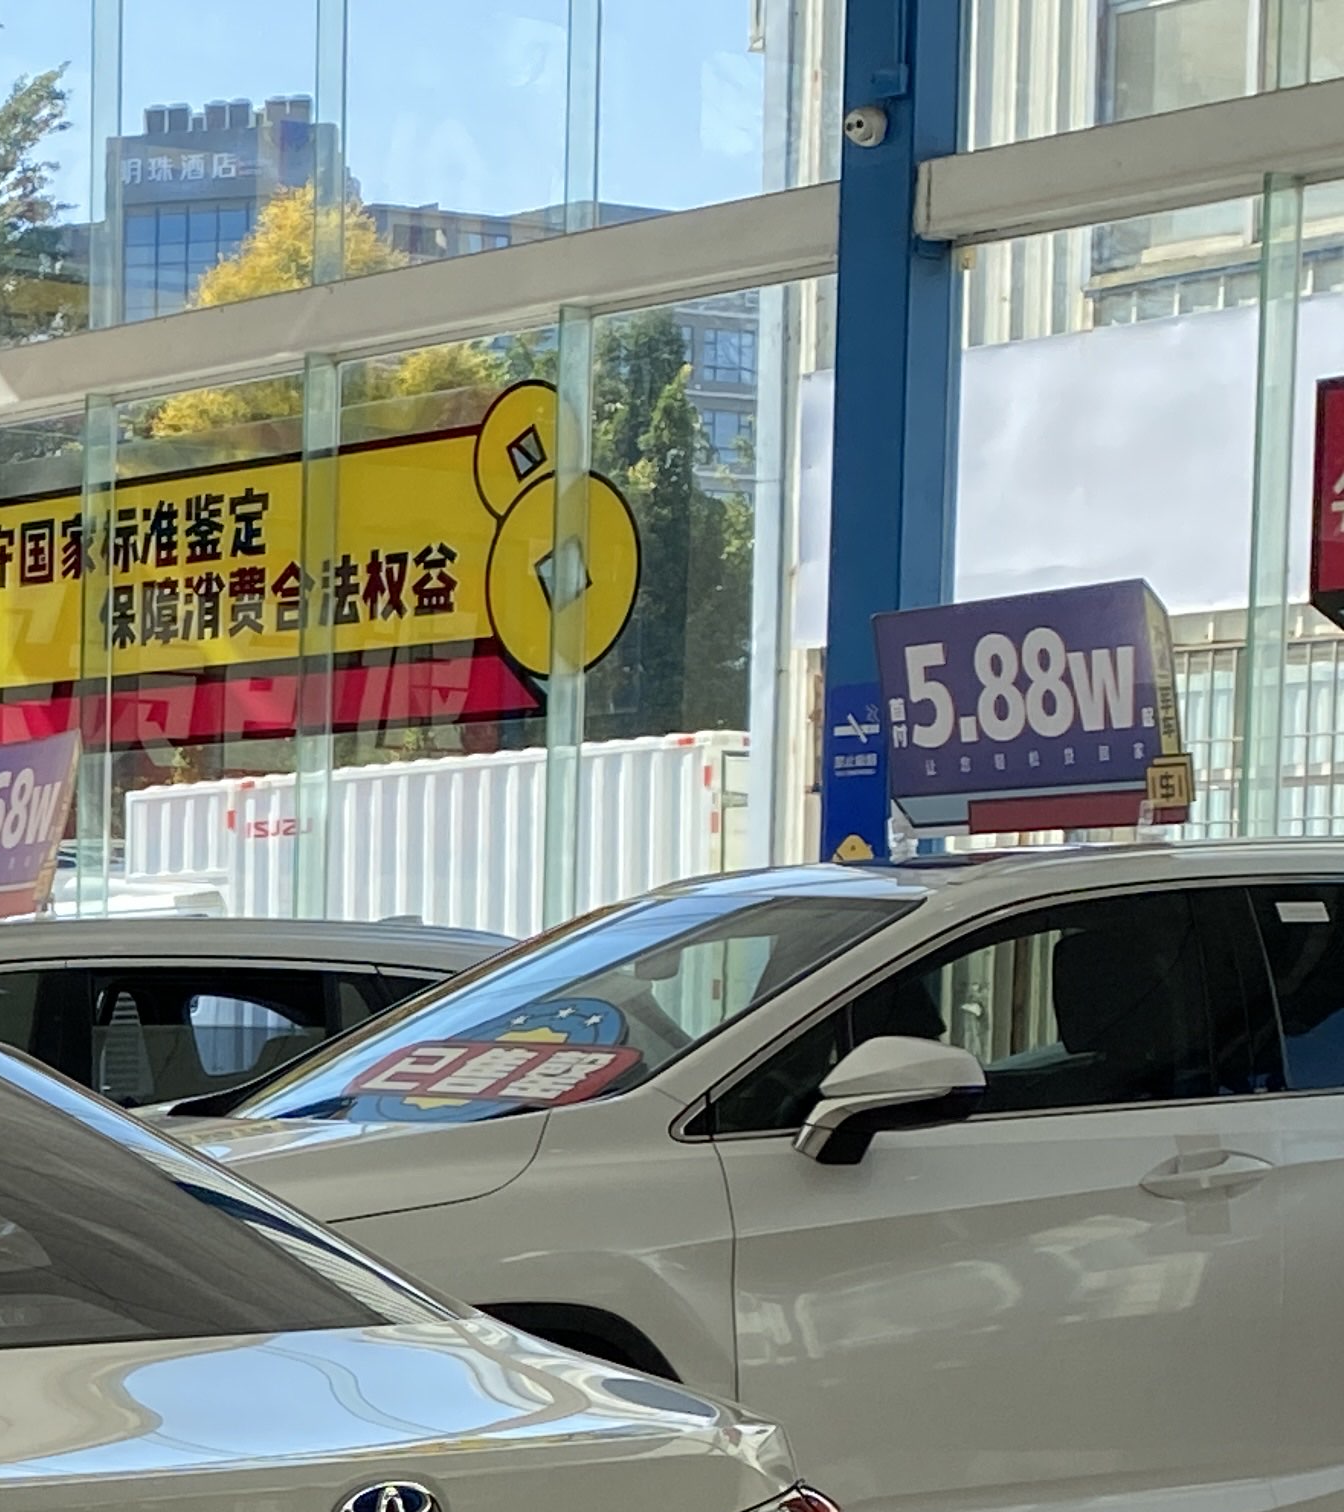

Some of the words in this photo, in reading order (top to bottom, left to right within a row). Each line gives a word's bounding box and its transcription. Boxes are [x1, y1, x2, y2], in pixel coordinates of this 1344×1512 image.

[100, 543, 458, 652] 保障消费合法权益
[905, 627, 1135, 749] 5.88W
